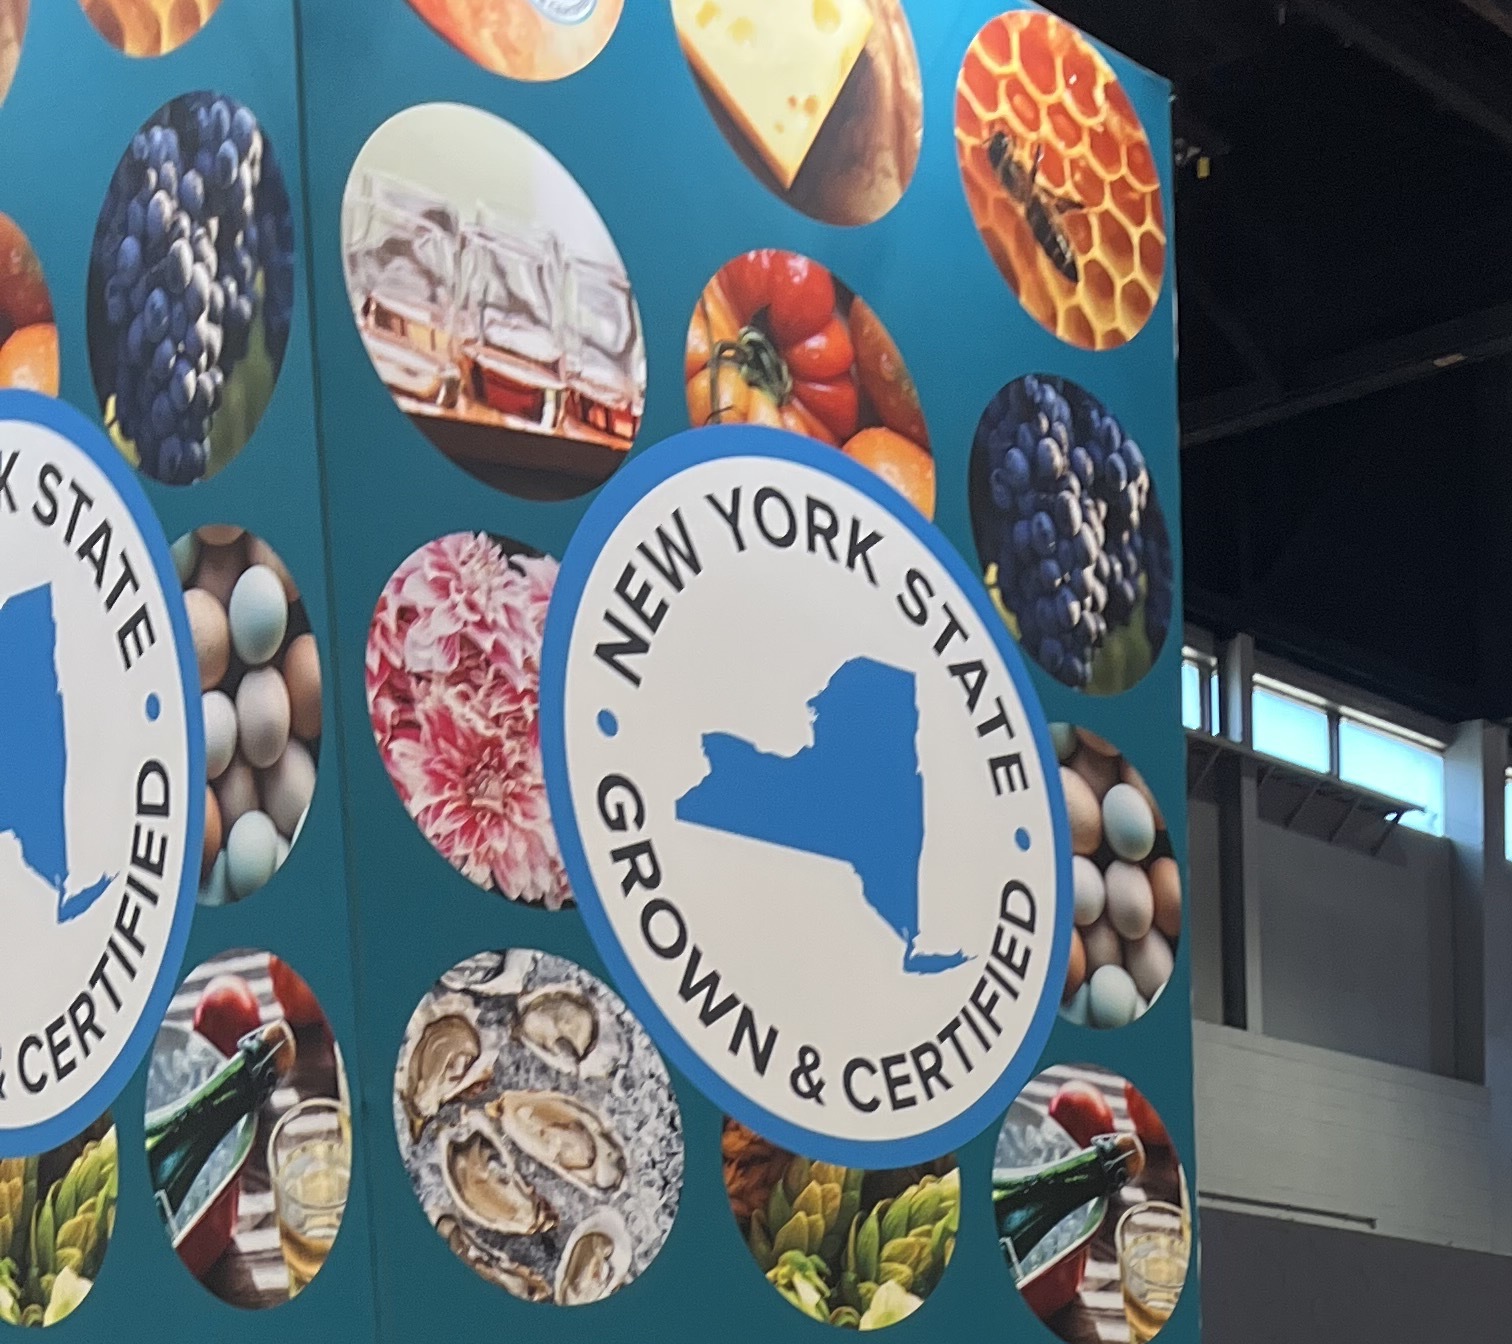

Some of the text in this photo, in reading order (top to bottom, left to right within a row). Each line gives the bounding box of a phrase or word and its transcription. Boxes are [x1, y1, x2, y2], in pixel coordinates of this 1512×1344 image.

[31, 462, 156, 672] STATE
[594, 486, 1031, 798] NEW YORK STATE
[17, 758, 171, 1096] CERTIFIED
[596, 772, 1037, 1115] GROWN & CERTIFIED
